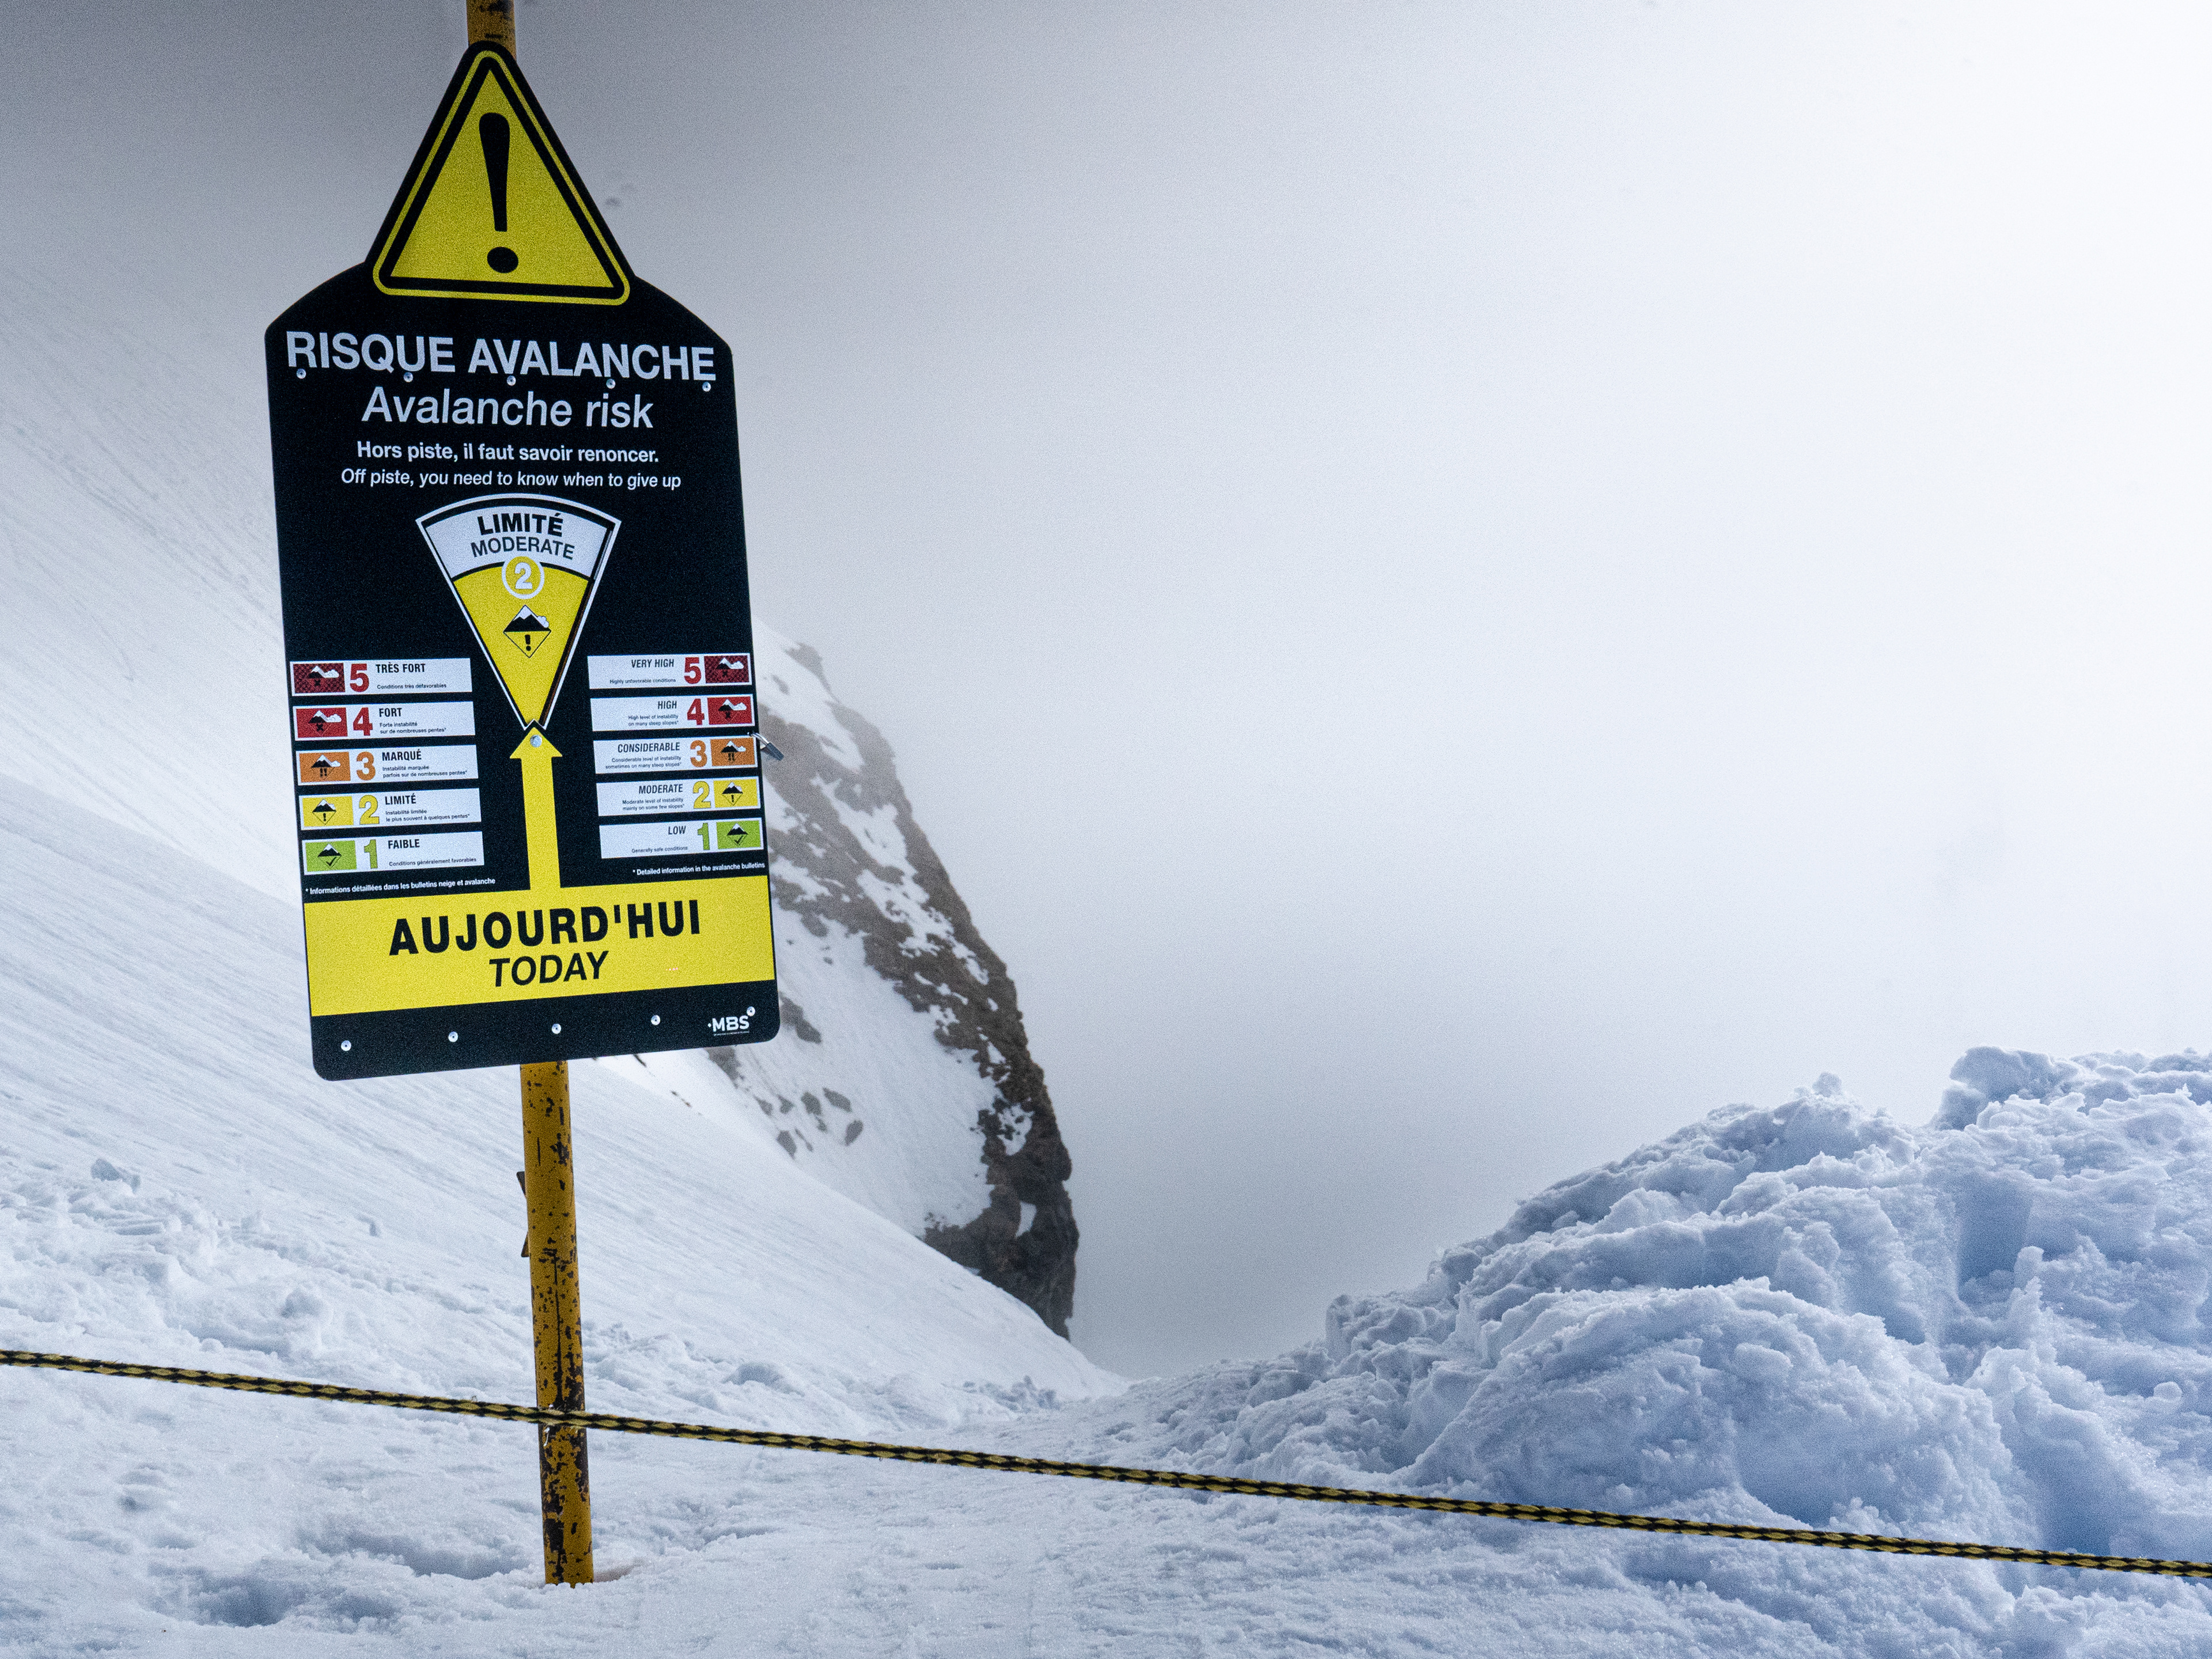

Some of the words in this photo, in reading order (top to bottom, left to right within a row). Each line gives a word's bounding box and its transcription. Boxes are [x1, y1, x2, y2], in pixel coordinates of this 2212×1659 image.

[286, 331, 455, 373] RISQUE
[468, 339, 715, 381] AVALANCHE
[361, 387, 572, 426] Avalanche
[586, 393, 653, 428] risk
[357, 441, 402, 458] Hors
[408, 442, 458, 462] piste,
[463, 443, 473, 459] il
[478, 443, 514, 460] faut
[519, 445, 573, 461] savoir
[578, 449, 658, 462] renoncer.
[341, 468, 366, 483] Off
[370, 469, 414, 487] piste,
[419, 473, 448, 488] you
[453, 471, 493, 485] need
[497, 471, 513, 485] to
[518, 471, 558, 486] know
[563, 472, 603, 486] when
[608, 473, 623, 487] to
[627, 473, 658, 490] give
[662, 476, 681, 490] up
[477, 513, 563, 537] LIMITÉ
[471, 536, 575, 560] MODERATE
[514, 562, 532, 589] 2
[376, 662, 399, 673] TRÈS
[403, 664, 425, 672] FORT
[631, 659, 652, 668] VERY
[655, 659, 674, 667] HIGH
[684, 657, 701, 684] 5
[350, 664, 369, 692] 5
[379, 708, 402, 717] FORT
[658, 701, 677, 709] HIGH
[687, 699, 704, 725] 4
[353, 707, 373, 736] 4
[382, 749, 422, 761] MARQUÉ
[618, 743, 680, 752] CONSIDERABLE
[690, 740, 707, 767] 3
[357, 752, 376, 781] 3
[385, 793, 416, 805] LIMITÉ
[639, 784, 683, 794] MODERATE
[693, 781, 711, 809] 2
[359, 795, 380, 825] 2
[668, 826, 686, 835] LOW
[698, 823, 710, 850] 1
[364, 839, 378, 869] 1
[388, 839, 420, 849] FAIBLE
[637, 868, 661, 876] Detailed
[309, 886, 351, 895] Informations
[411, 881, 438, 889] bulletins
[464, 877, 496, 885] avalanche
[389, 900, 700, 956] AUJOURD'HUI
[489, 950, 609, 987] TODAY
[712, 1016, 749, 1032] MBS
